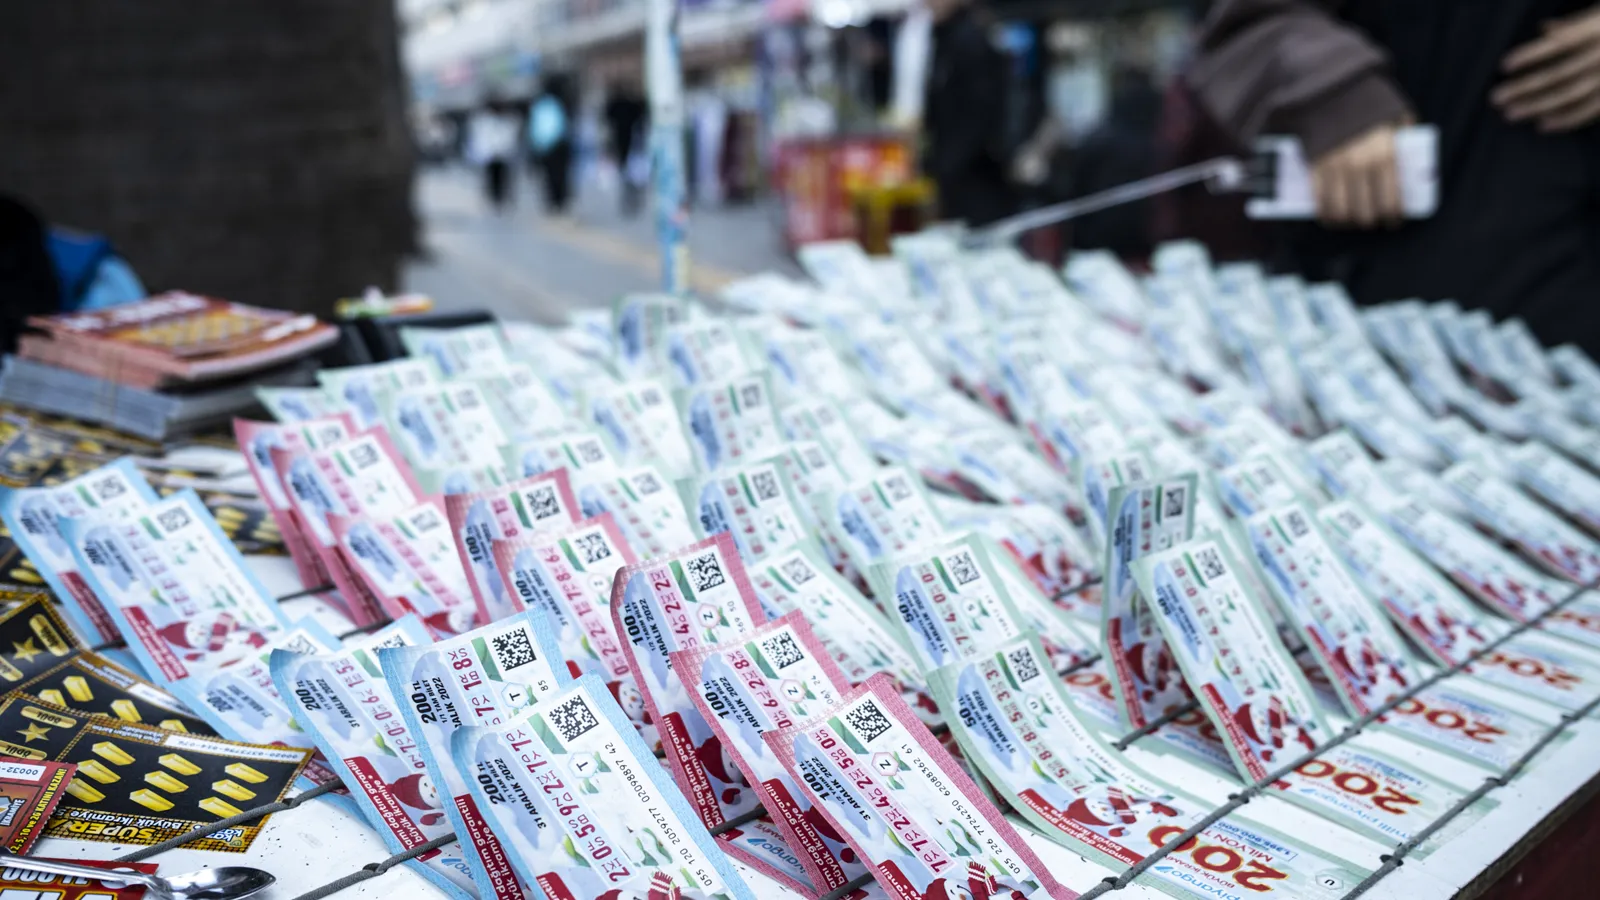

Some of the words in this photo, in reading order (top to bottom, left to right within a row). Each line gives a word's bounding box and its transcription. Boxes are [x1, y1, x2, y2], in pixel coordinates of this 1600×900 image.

[655, 579, 672, 592] 2
[624, 604, 635, 614] TL
[639, 598, 654, 622] 2022
[664, 602, 682, 614] 2
[624, 616, 644, 646] 100
[676, 623, 690, 636] 4
[650, 624, 670, 657] ARALIK
[452, 657, 472, 670] 8
[734, 658, 750, 670] 8
[316, 678, 333, 698] 2022
[412, 680, 422, 690] TL
[432, 676, 450, 701] 2022
[464, 680, 483, 691] 1
[704, 680, 714, 690] TL
[718, 676, 738, 698] 2022
[748, 678, 766, 690] 2
[788, 686, 798, 696] Z
[295, 689, 321, 712] 200
[431, 696, 444, 712] TAM
[509, 692, 521, 701] T
[724, 696, 740, 714] YARIM
[764, 698, 778, 710] 6
[972, 690, 990, 714] 2022
[331, 697, 355, 722] ARALIK
[411, 693, 437, 725] 200
[474, 706, 496, 718] 7
[704, 691, 731, 720] 100
[735, 698, 761, 728] ARALIK
[350, 718, 360, 728] 31
[374, 711, 393, 721] 0
[777, 719, 794, 730] 0
[958, 708, 977, 728] 50
[387, 727, 406, 738] 0
[986, 713, 1008, 743] ARALIK
[510, 739, 532, 752] 7
[662, 716, 688, 763] garantili
[820, 738, 837, 750] 0
[1024, 732, 1038, 742] 8
[5, 745, 32, 758] ÖDÜL
[604, 742, 617, 754] 42
[900, 744, 913, 754] 61
[1038, 750, 1053, 761] 8
[476, 761, 486, 773] TL
[494, 758, 515, 782] 2022
[526, 760, 548, 774] 7
[576, 760, 589, 772] T
[685, 744, 712, 792] ikramiye
[799, 762, 810, 772] TL
[811, 757, 834, 780] 2022
[837, 760, 855, 770] 5
[880, 759, 892, 770] Z
[344, 759, 376, 795] garantili
[498, 776, 514, 794] TAM
[615, 758, 650, 804] 02098897
[685, 763, 706, 807] dağıtım
[856, 776, 874, 790] 2
[913, 756, 951, 797] 62088362
[477, 774, 507, 805] 200
[543, 779, 565, 794] 2
[804, 773, 830, 802] 100
[823, 778, 840, 798] YARIM
[832, 778, 862, 812] ARALIK
[1293, 759, 1421, 815] 200
[373, 779, 405, 821] ikramiye
[514, 782, 539, 816] ARALIK
[764, 782, 797, 827] garantili
[874, 798, 894, 810] 4
[372, 793, 400, 830] dağıtım
[559, 804, 580, 817] 9
[706, 791, 724, 826] büyük
[858, 810, 872, 821] 31
[1020, 794, 1060, 825] garantili
[70, 810, 133, 827] İkramiye
[137, 818, 182, 830] Büyük
[457, 798, 488, 848] garantili
[534, 816, 548, 830] 31
[648, 806, 681, 846] 2059277
[892, 819, 911, 831] 2
[951, 799, 985, 836] 7724250
[69, 820, 158, 840] SÜPER
[402, 818, 424, 842] büyük
[574, 823, 596, 839] 5
[792, 808, 825, 856] ikramiye
[484, 827, 511, 879] ikramiye
[592, 844, 613, 861] 0
[794, 825, 825, 866] dağıtım
[912, 840, 929, 852] 7
[986, 838, 1003, 855] 226
[1214, 833, 1274, 863] MİLYON
[679, 847, 696, 866] 120
[1147, 825, 1290, 892] 200
[608, 866, 631, 882] 2
[822, 852, 846, 886] büyük
[929, 859, 948, 873] 7
[1004, 858, 1021, 875] 055
[696, 868, 713, 887] 055
